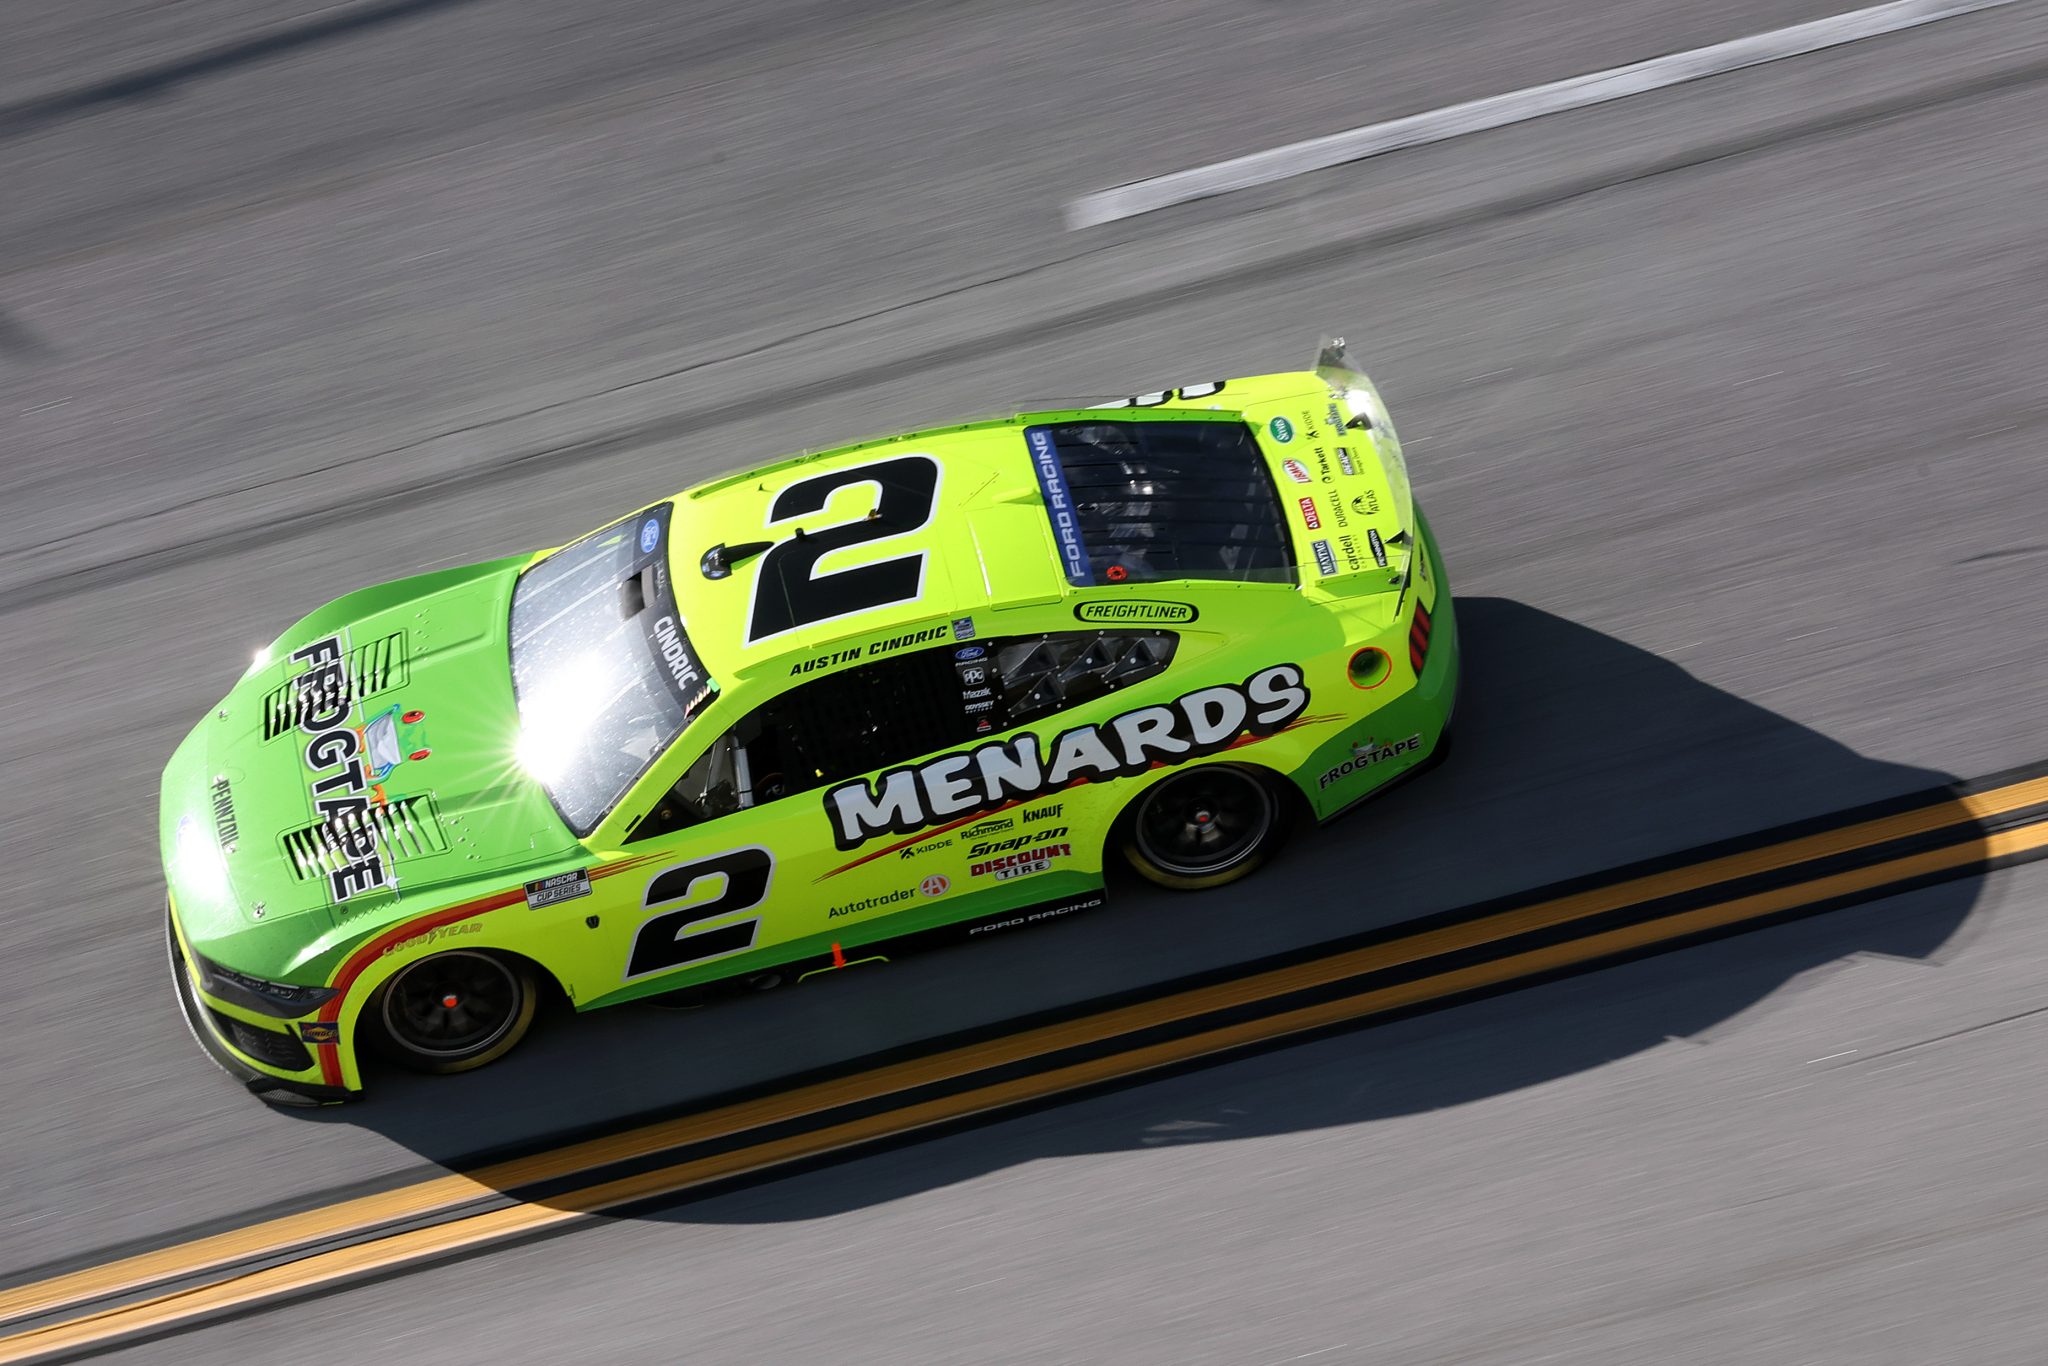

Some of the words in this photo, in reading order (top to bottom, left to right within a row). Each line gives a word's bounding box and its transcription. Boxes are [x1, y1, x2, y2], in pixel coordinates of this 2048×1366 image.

[1032, 433, 1067, 508] RACING
[1315, 447, 1329, 473] Tarkett
[1301, 498, 1317, 523] DELTA
[1328, 489, 1348, 527] DURACELL
[1366, 489, 1379, 512] ATLAS
[747, 455, 940, 645] 2
[1057, 514, 1084, 577] FORD
[1314, 541, 1335, 574] MAYTAG
[1339, 535, 1359, 570] cardell
[1369, 529, 1387, 567] PENNINGTON
[1086, 605, 1187, 618] FREIGHTLINER
[654, 615, 698, 690] CINDRIC
[790, 647, 861, 676] AUSTIN
[869, 625, 948, 655] CINDRIC
[960, 648, 980, 659] Ford
[964, 670, 983, 684] PPG
[965, 700, 994, 711] ODYSSEY
[290, 635, 386, 904] FROGTAPE
[828, 664, 1307, 846] MENARDS
[1319, 737, 1421, 789] FROGTAPE
[210, 779, 240, 847] PENNZOIL
[961, 818, 1013, 840] Richmond
[1023, 804, 1063, 823] KNAUF
[916, 839, 952, 854] KIDDE
[967, 827, 1068, 859] Snap-on
[971, 844, 1071, 877] DISCOUNT
[1000, 861, 1045, 879] TIRE
[537, 891, 552, 902] CUP
[554, 884, 580, 898] SERIES
[545, 872, 578, 888] NASCAR
[624, 846, 774, 981] 2
[828, 887, 916, 919] Autotrader
[969, 918, 1024, 935] FORD
[1028, 899, 1101, 921] RACING
[383, 923, 483, 957] GOODYEAR
